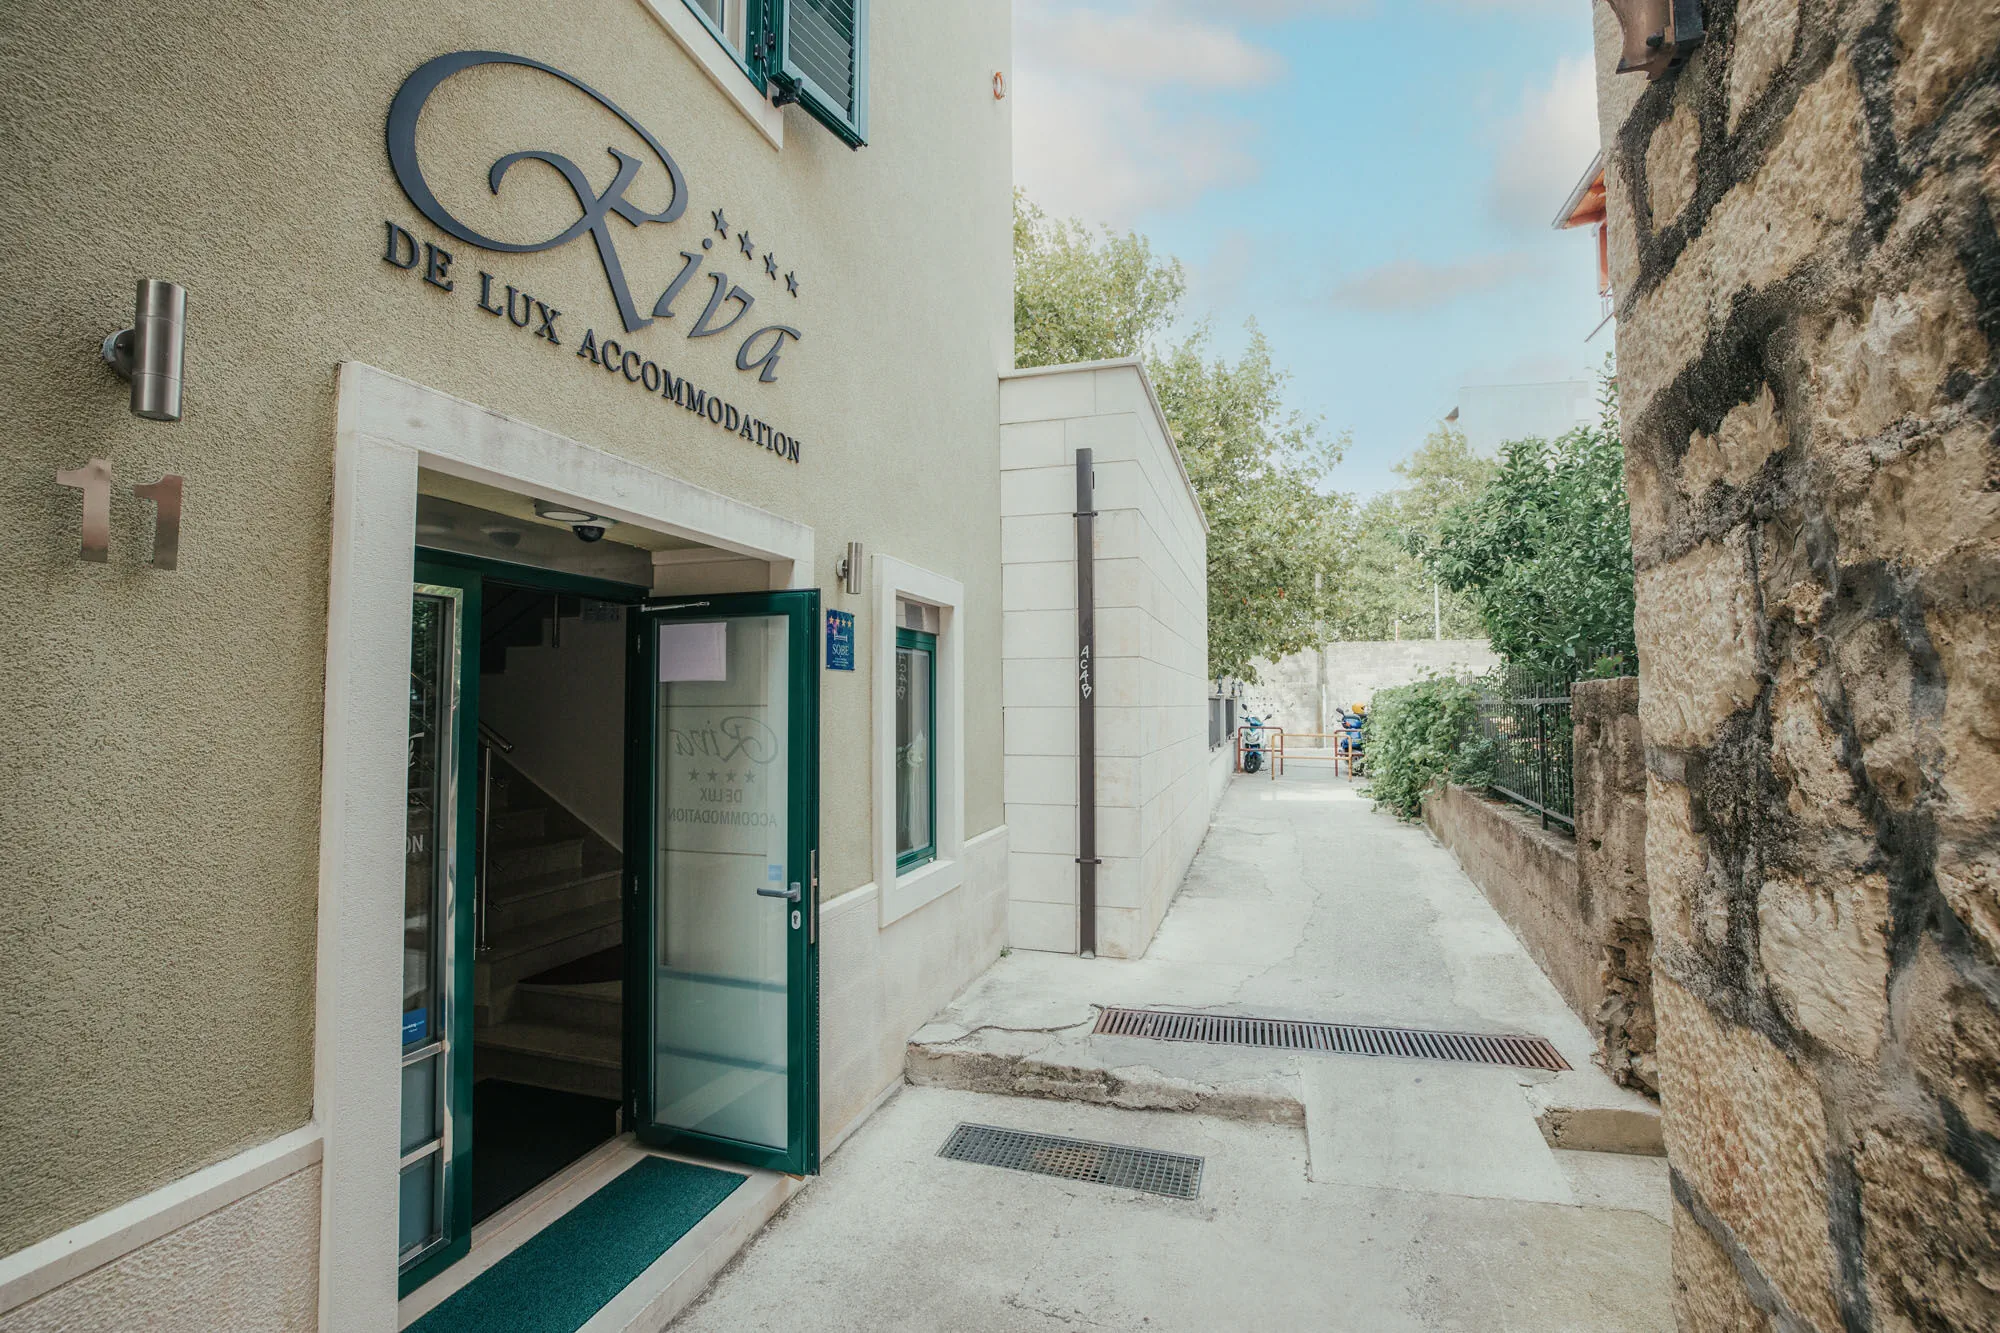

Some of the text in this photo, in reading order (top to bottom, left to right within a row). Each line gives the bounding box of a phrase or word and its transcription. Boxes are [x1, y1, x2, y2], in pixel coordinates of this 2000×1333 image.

[386, 50, 801, 383] Riva
[383, 220, 801, 464] DE LUX ACCOMMODATION
[56, 457, 184, 571] 11
[1080, 644, 1092, 699] ACAB
